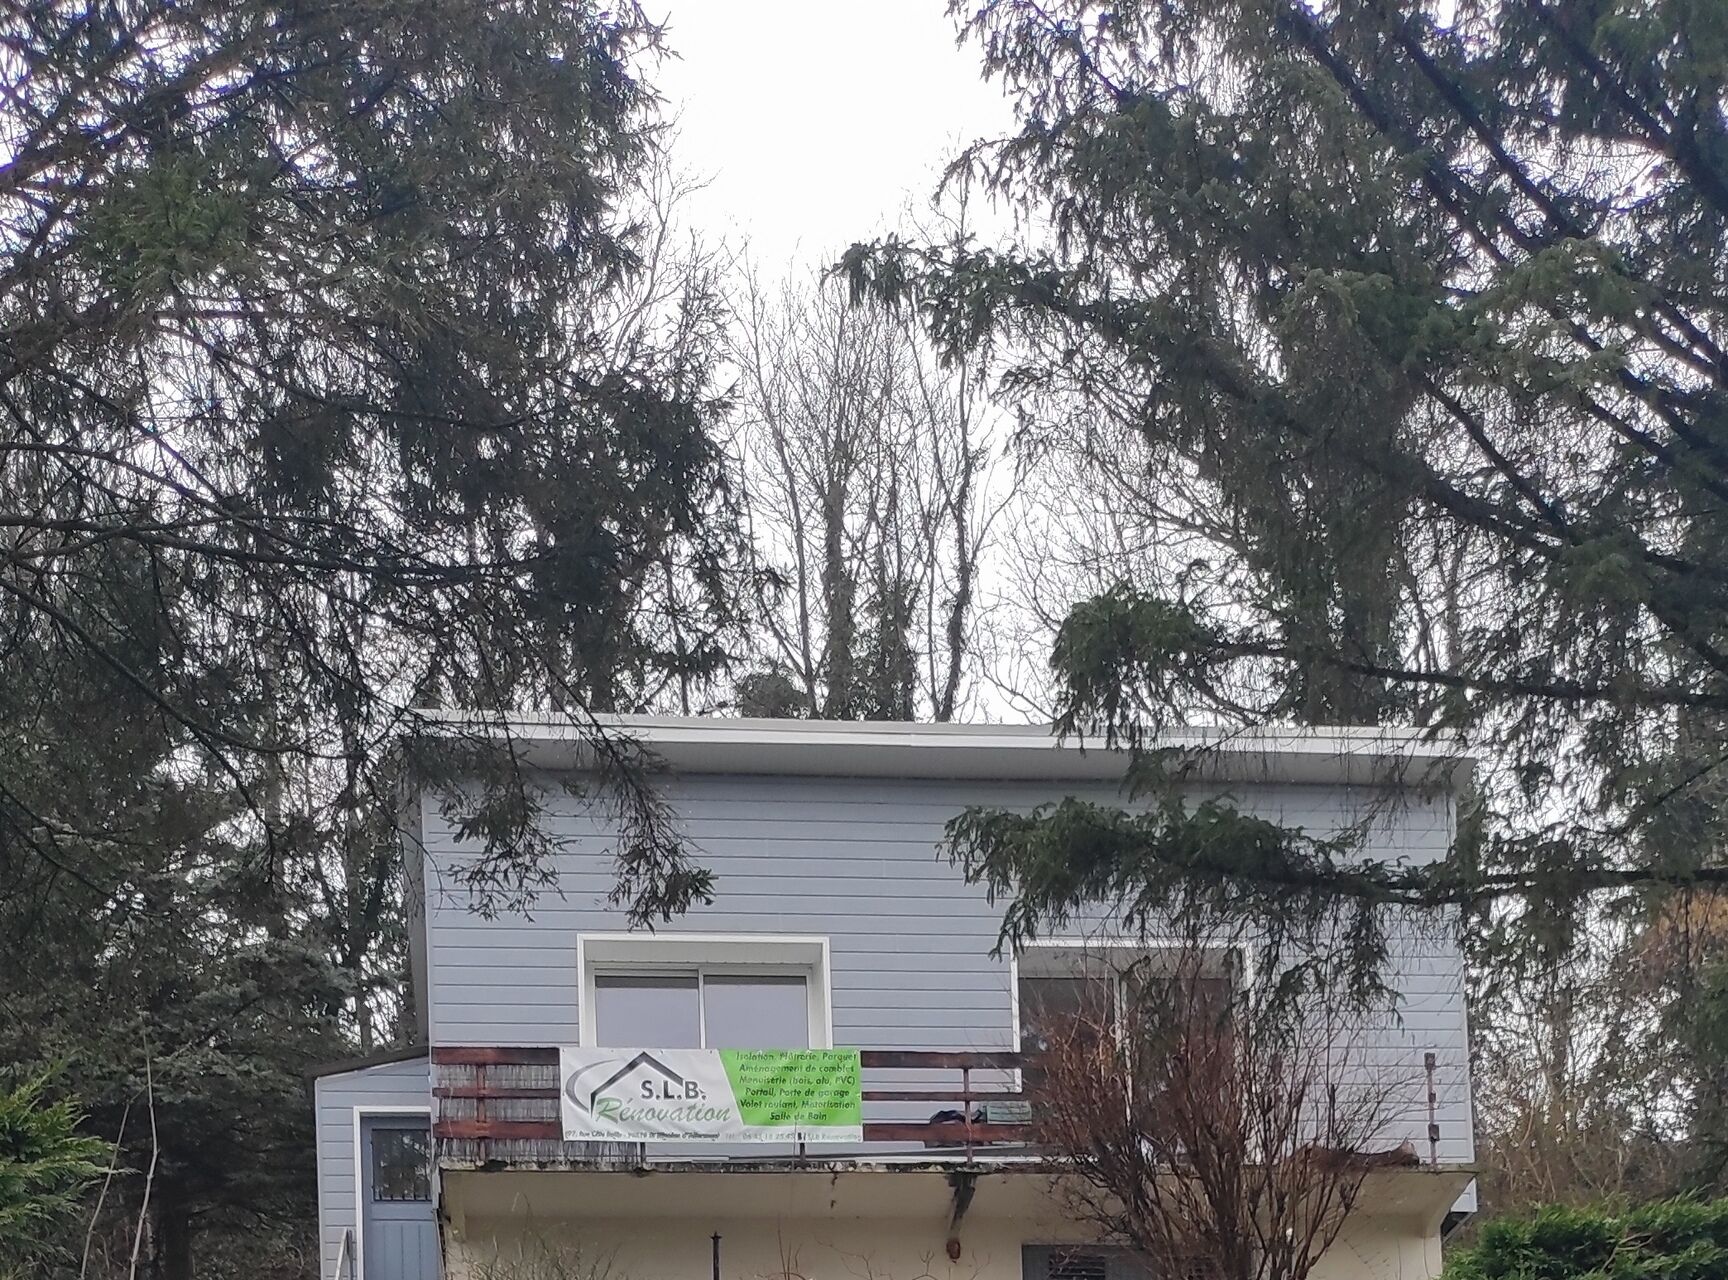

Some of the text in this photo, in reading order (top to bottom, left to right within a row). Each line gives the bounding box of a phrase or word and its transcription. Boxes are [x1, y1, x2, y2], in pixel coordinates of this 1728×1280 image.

[822, 1052, 857, 1063] Parquet
[805, 1064, 817, 1072] de
[819, 1063, 854, 1073] combles
[835, 1075, 856, 1087] PVC)
[641, 1080, 707, 1100] S.L.B.
[779, 1087, 802, 1097] Porte
[804, 1087, 815, 1097] de
[818, 1088, 850, 1099] garage
[740, 1098, 763, 1109] Volet
[801, 1098, 856, 1109] Motorisation
[595, 1096, 731, 1124] Rénovation
[769, 1111, 827, 1121] Salle de Bain
